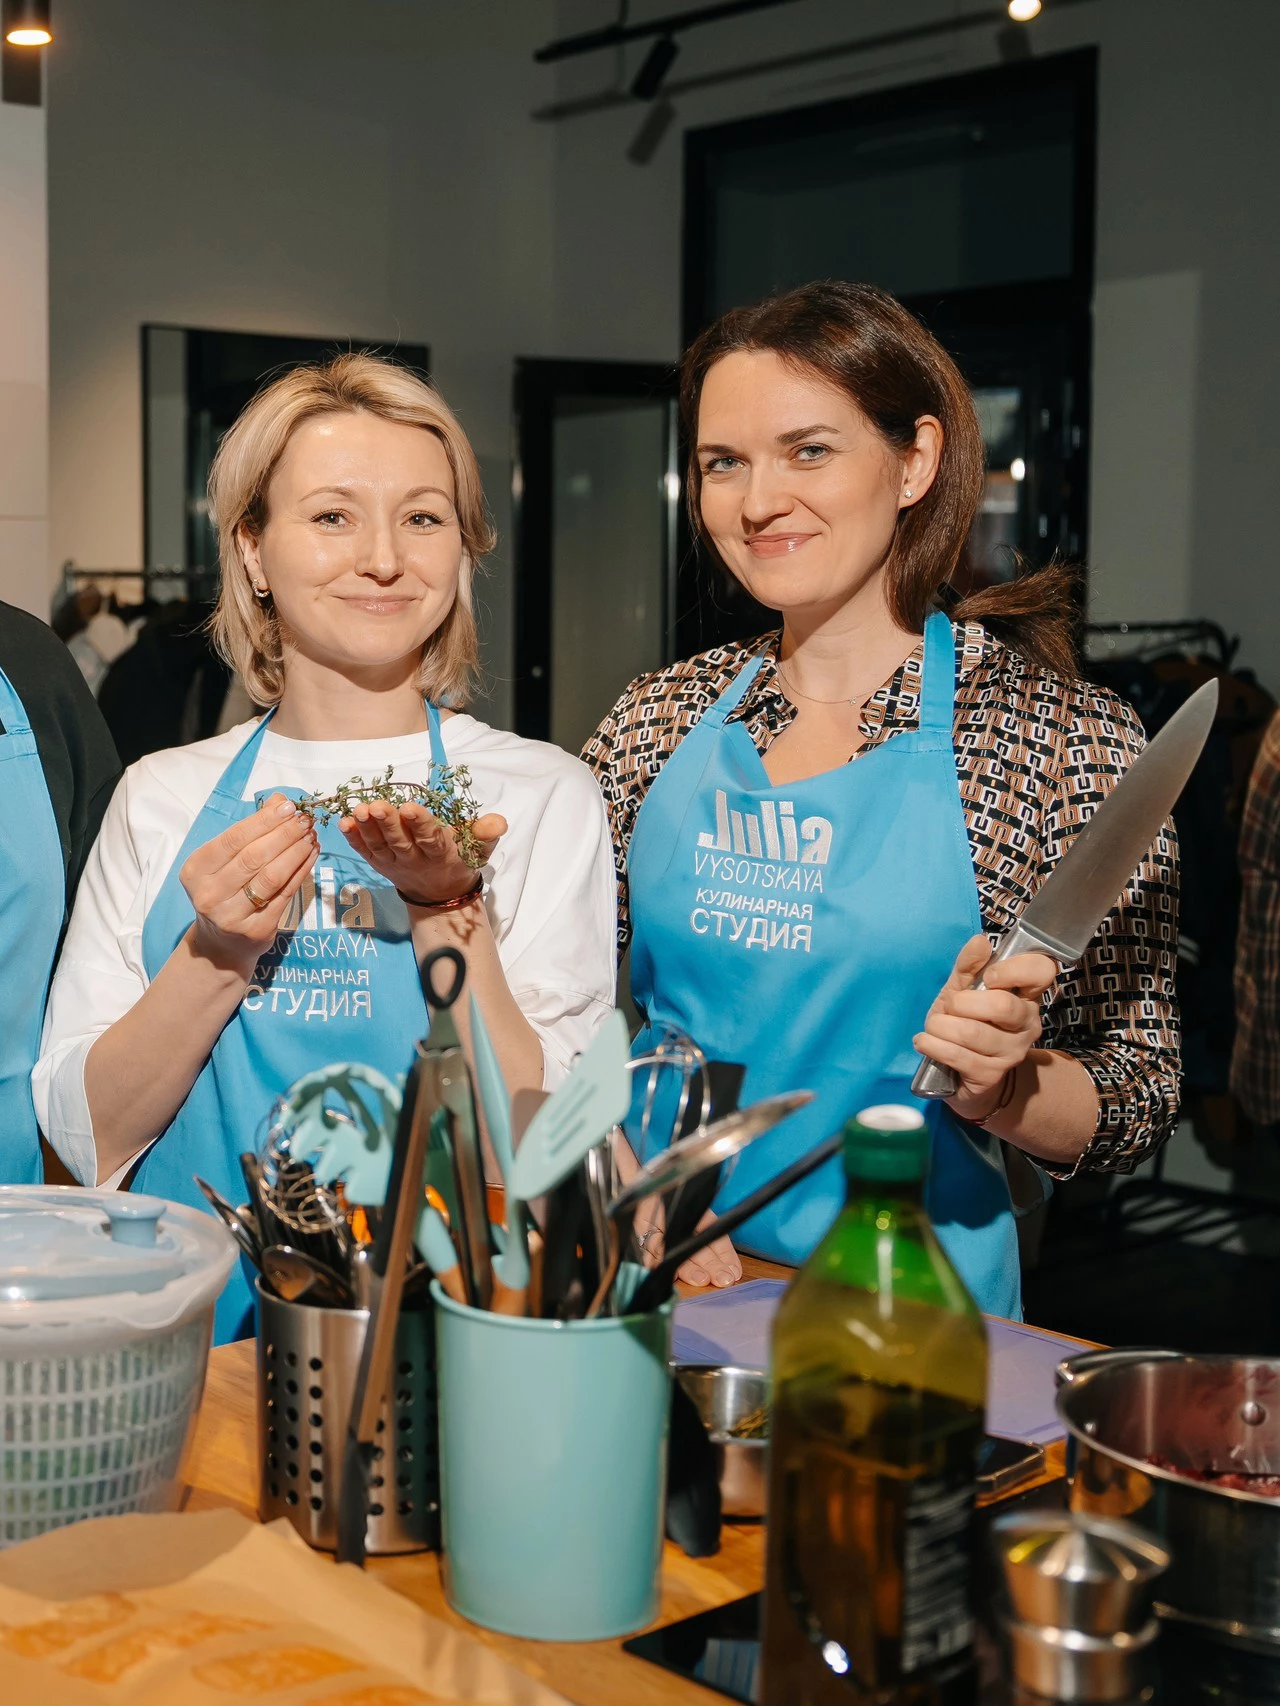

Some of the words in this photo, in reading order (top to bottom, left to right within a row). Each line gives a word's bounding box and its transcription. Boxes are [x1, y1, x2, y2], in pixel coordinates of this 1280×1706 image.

[697, 789, 831, 863] Julia
[695, 851, 822, 892] VYSOTSKAYA
[696, 888, 811, 919] КУЛИНАРНАЯ
[268, 933, 377, 956] OTSKAYA
[690, 908, 811, 951] СТУДИЯ
[244, 985, 370, 1021] СТУДИЯ
